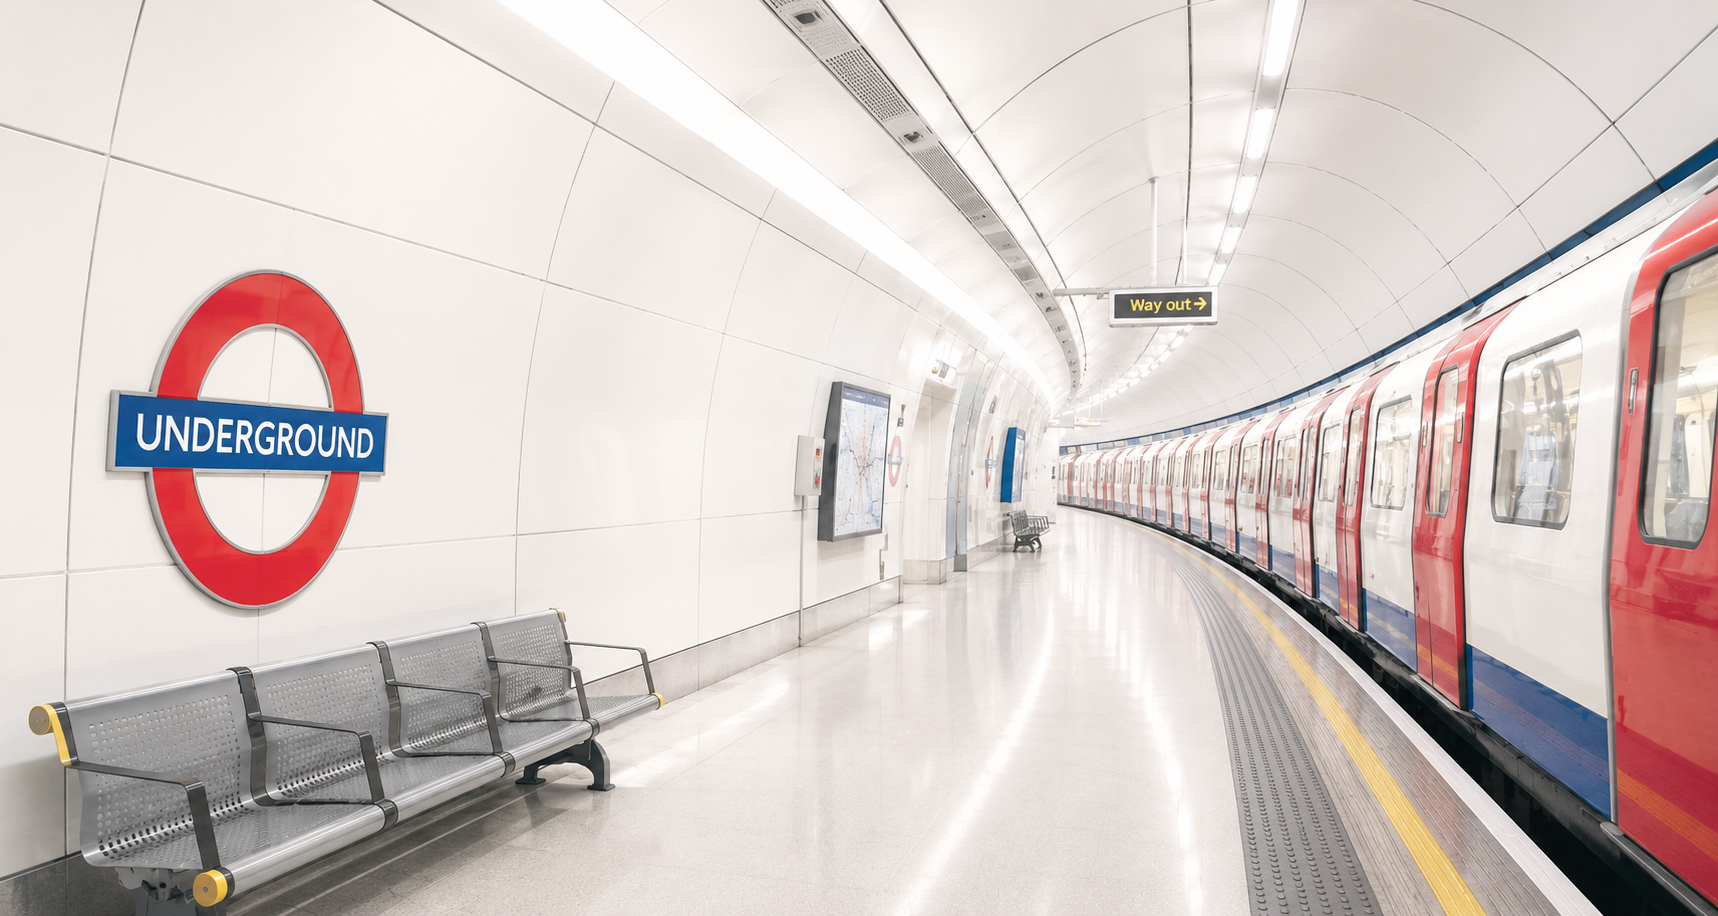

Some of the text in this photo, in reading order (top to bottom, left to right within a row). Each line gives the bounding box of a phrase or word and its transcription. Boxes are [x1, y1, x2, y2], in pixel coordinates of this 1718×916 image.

[1130, 298, 1192, 314] Way out
[136, 413, 374, 458] UNDERGROUND
